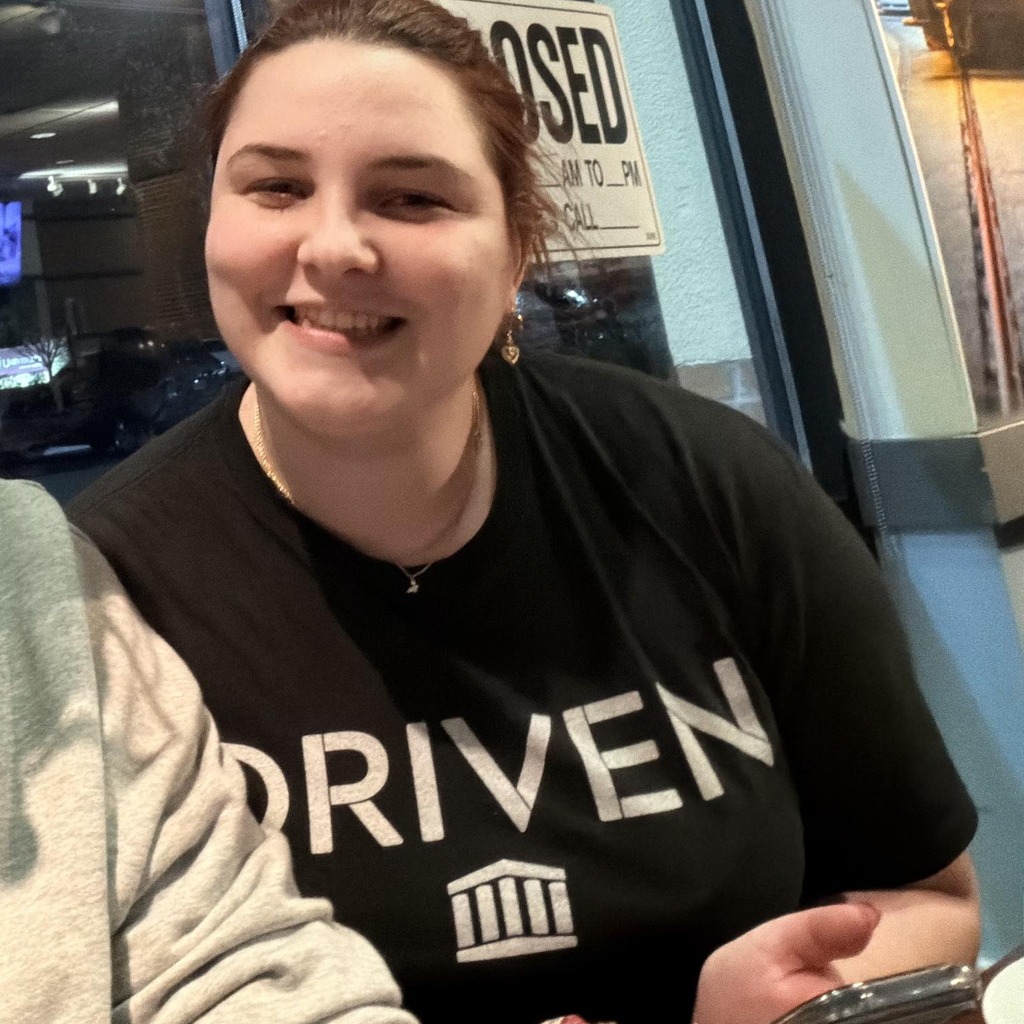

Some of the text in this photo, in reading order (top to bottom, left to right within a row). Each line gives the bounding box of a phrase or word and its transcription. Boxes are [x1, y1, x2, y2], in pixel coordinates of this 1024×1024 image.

[489, 20, 628, 144] OSED
[584, 159, 604, 187] TO
[564, 202, 599, 231] CALL
